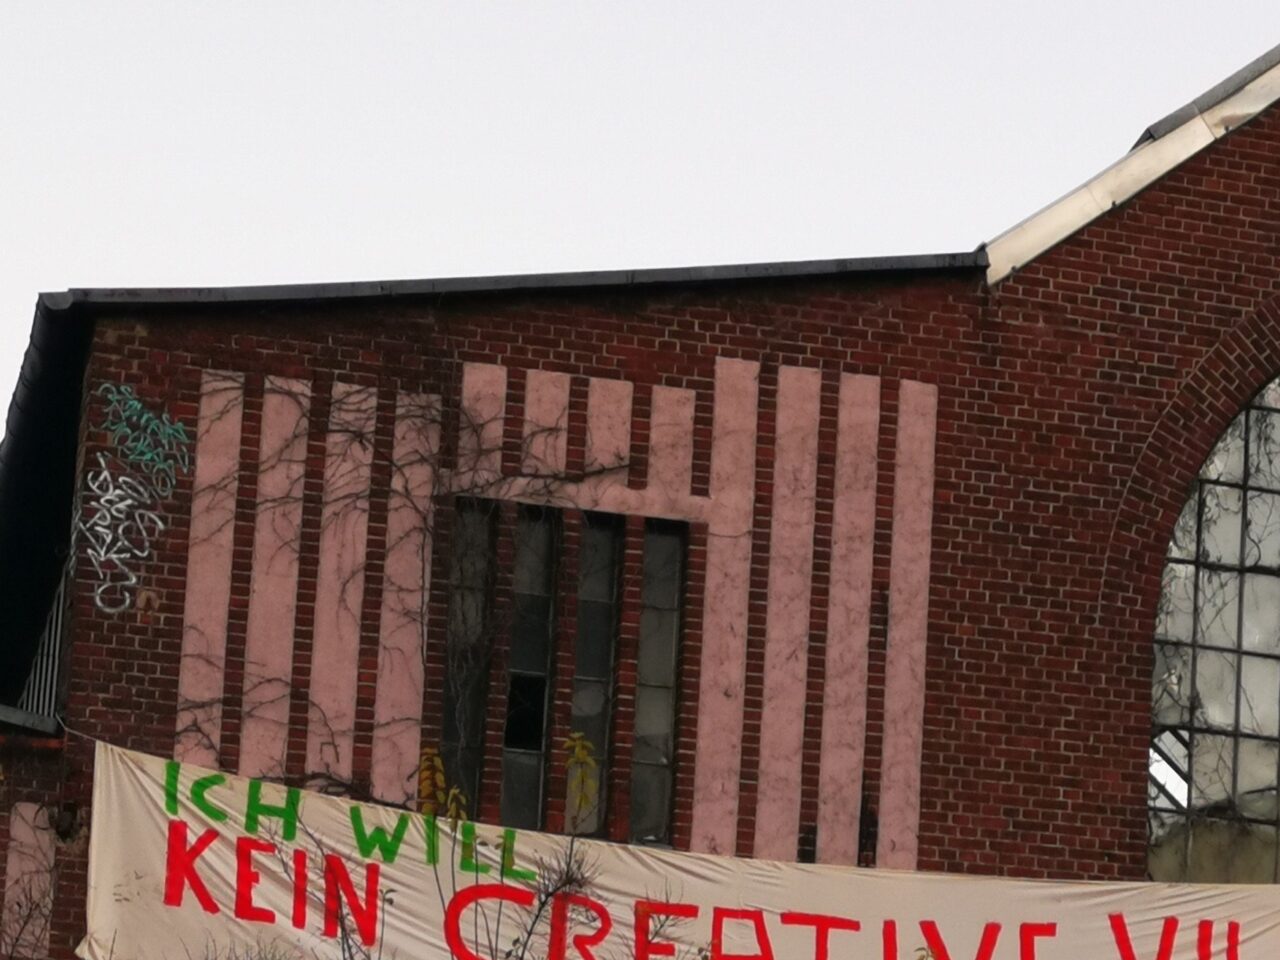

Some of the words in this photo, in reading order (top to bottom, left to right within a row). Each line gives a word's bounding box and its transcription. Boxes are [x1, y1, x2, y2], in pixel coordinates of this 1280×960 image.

[163, 760, 302, 842] ICH
[349, 805, 537, 882] WILL
[163, 820, 380, 948] KEIN
